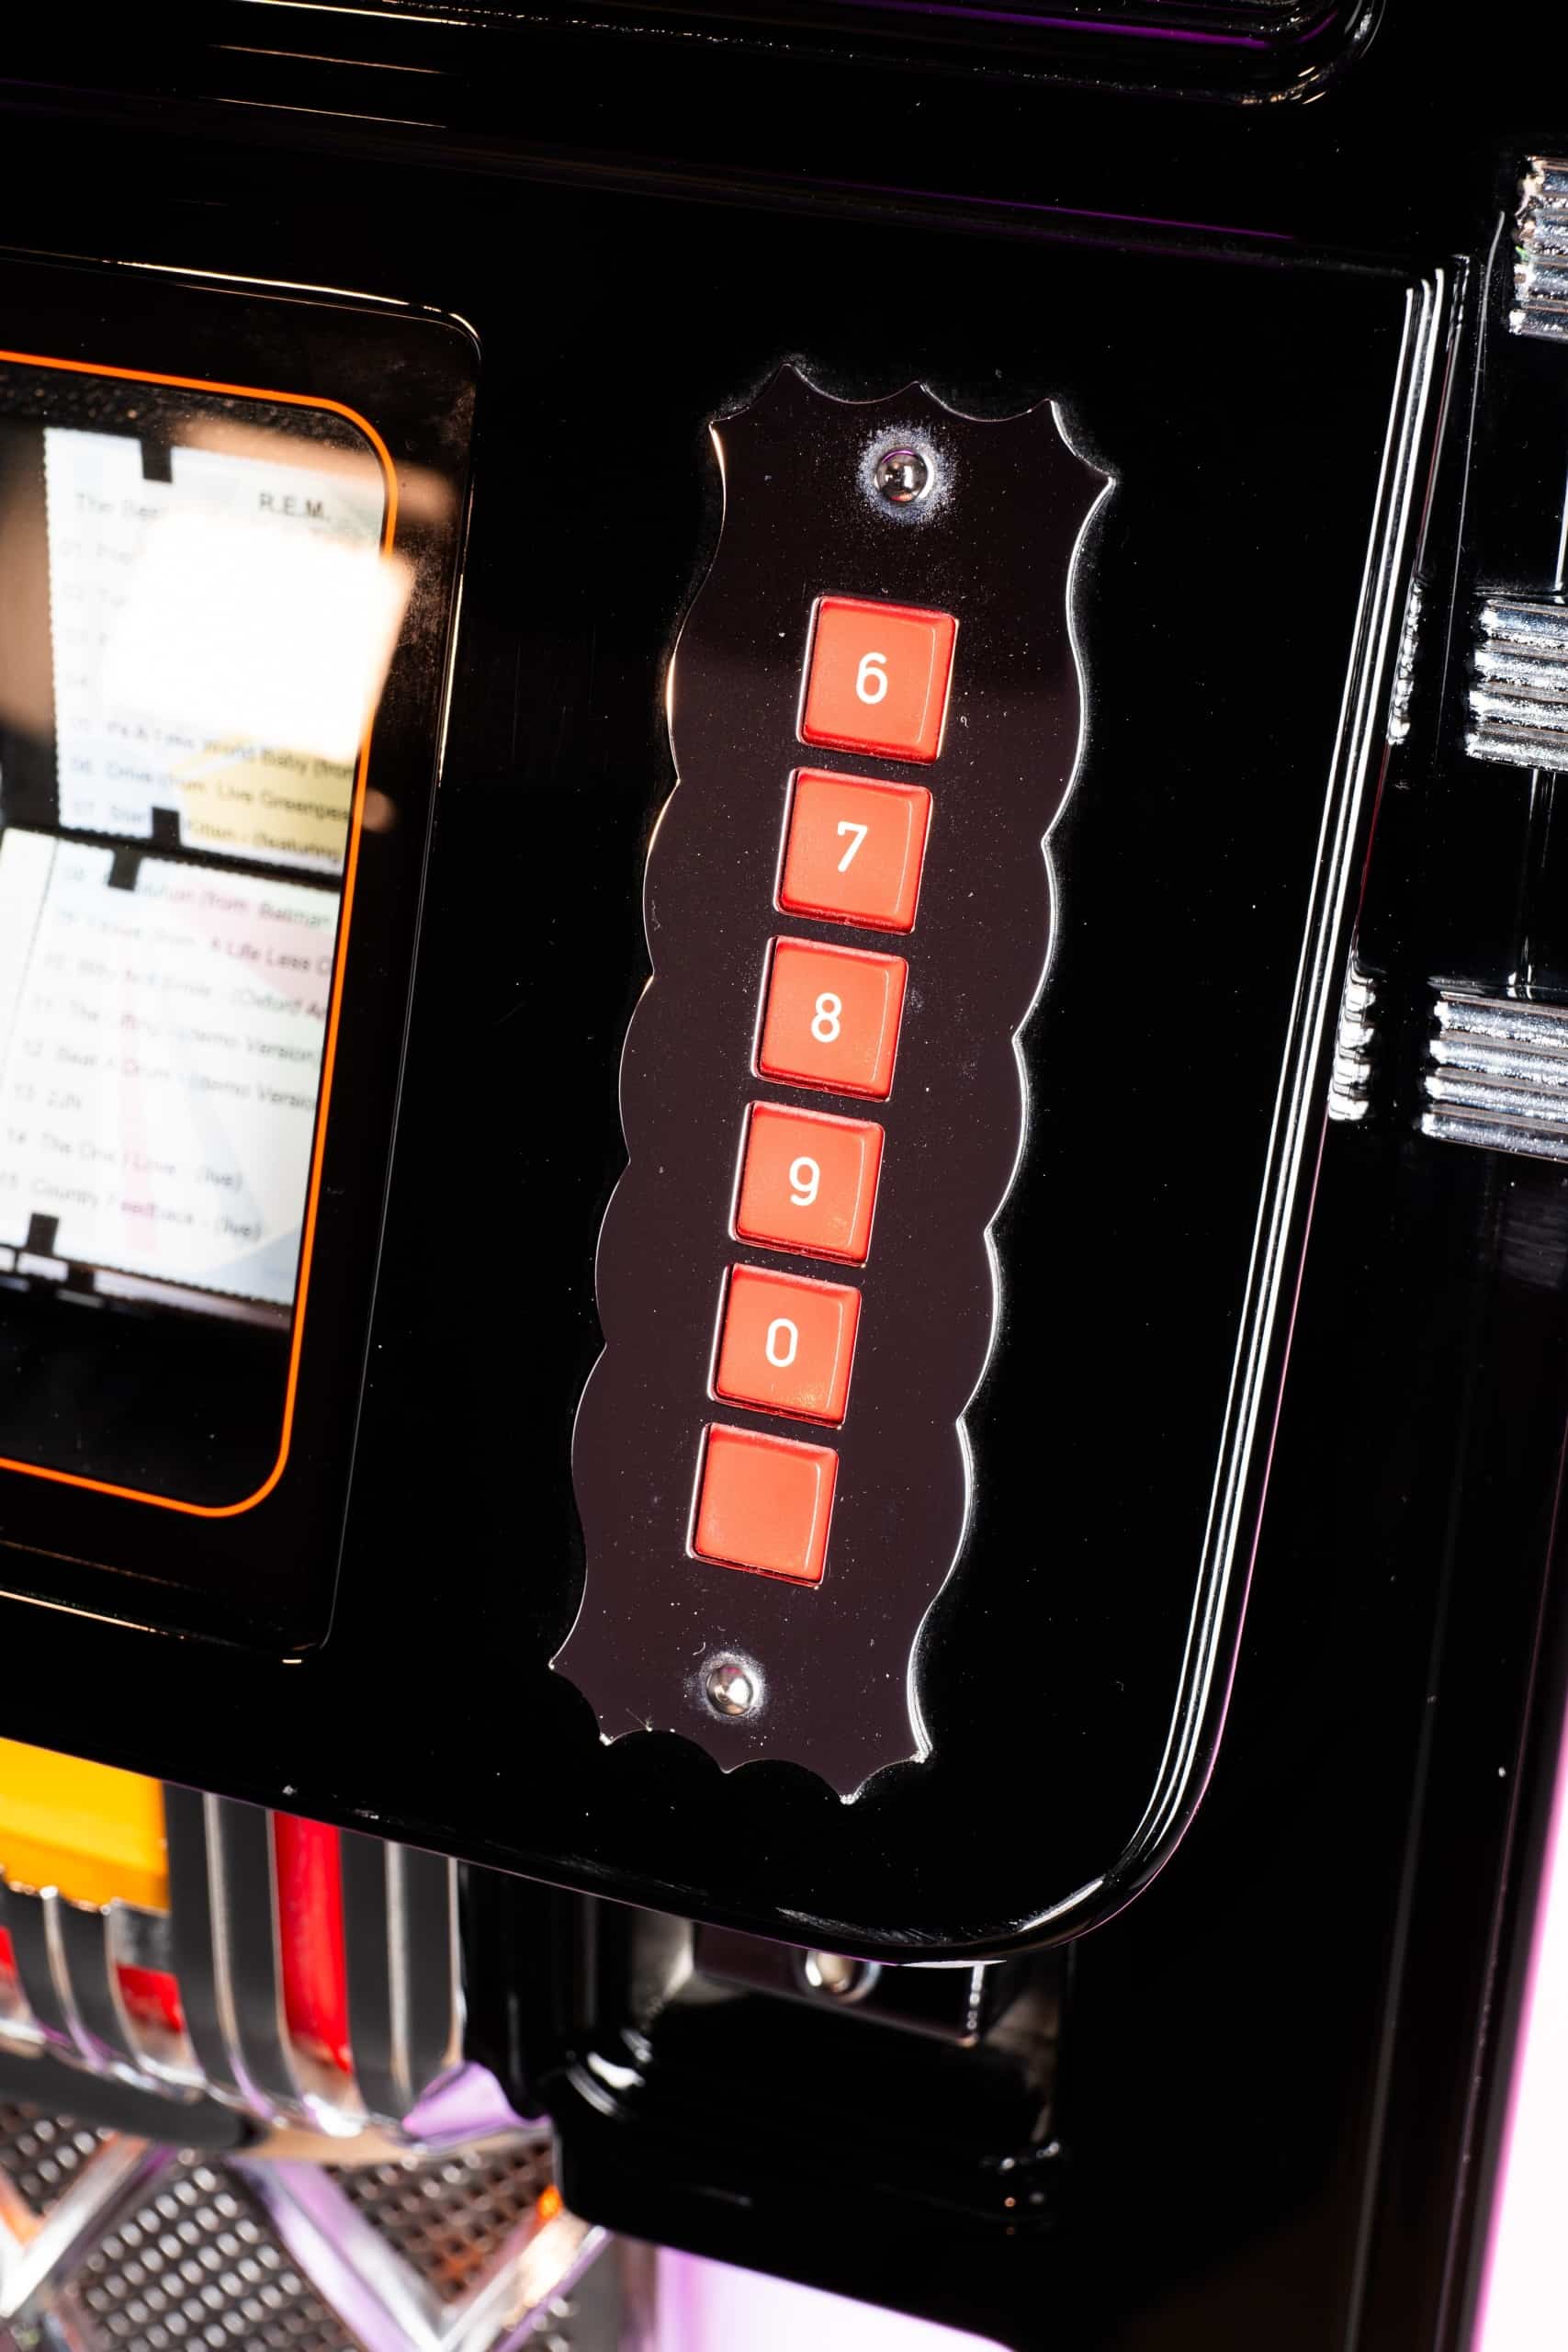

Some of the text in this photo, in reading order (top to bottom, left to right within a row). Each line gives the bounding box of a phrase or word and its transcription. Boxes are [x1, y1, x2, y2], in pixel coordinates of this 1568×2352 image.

[258, 492, 332, 521] R.E.M.
[854, 651, 889, 705] 6
[261, 745, 308, 775] Baby
[837, 820, 870, 873] 7
[226, 941, 261, 962] Life
[265, 946, 312, 973] Less
[809, 992, 843, 1043] 8
[787, 1156, 822, 1206] 9
[764, 1317, 800, 1368] 0
